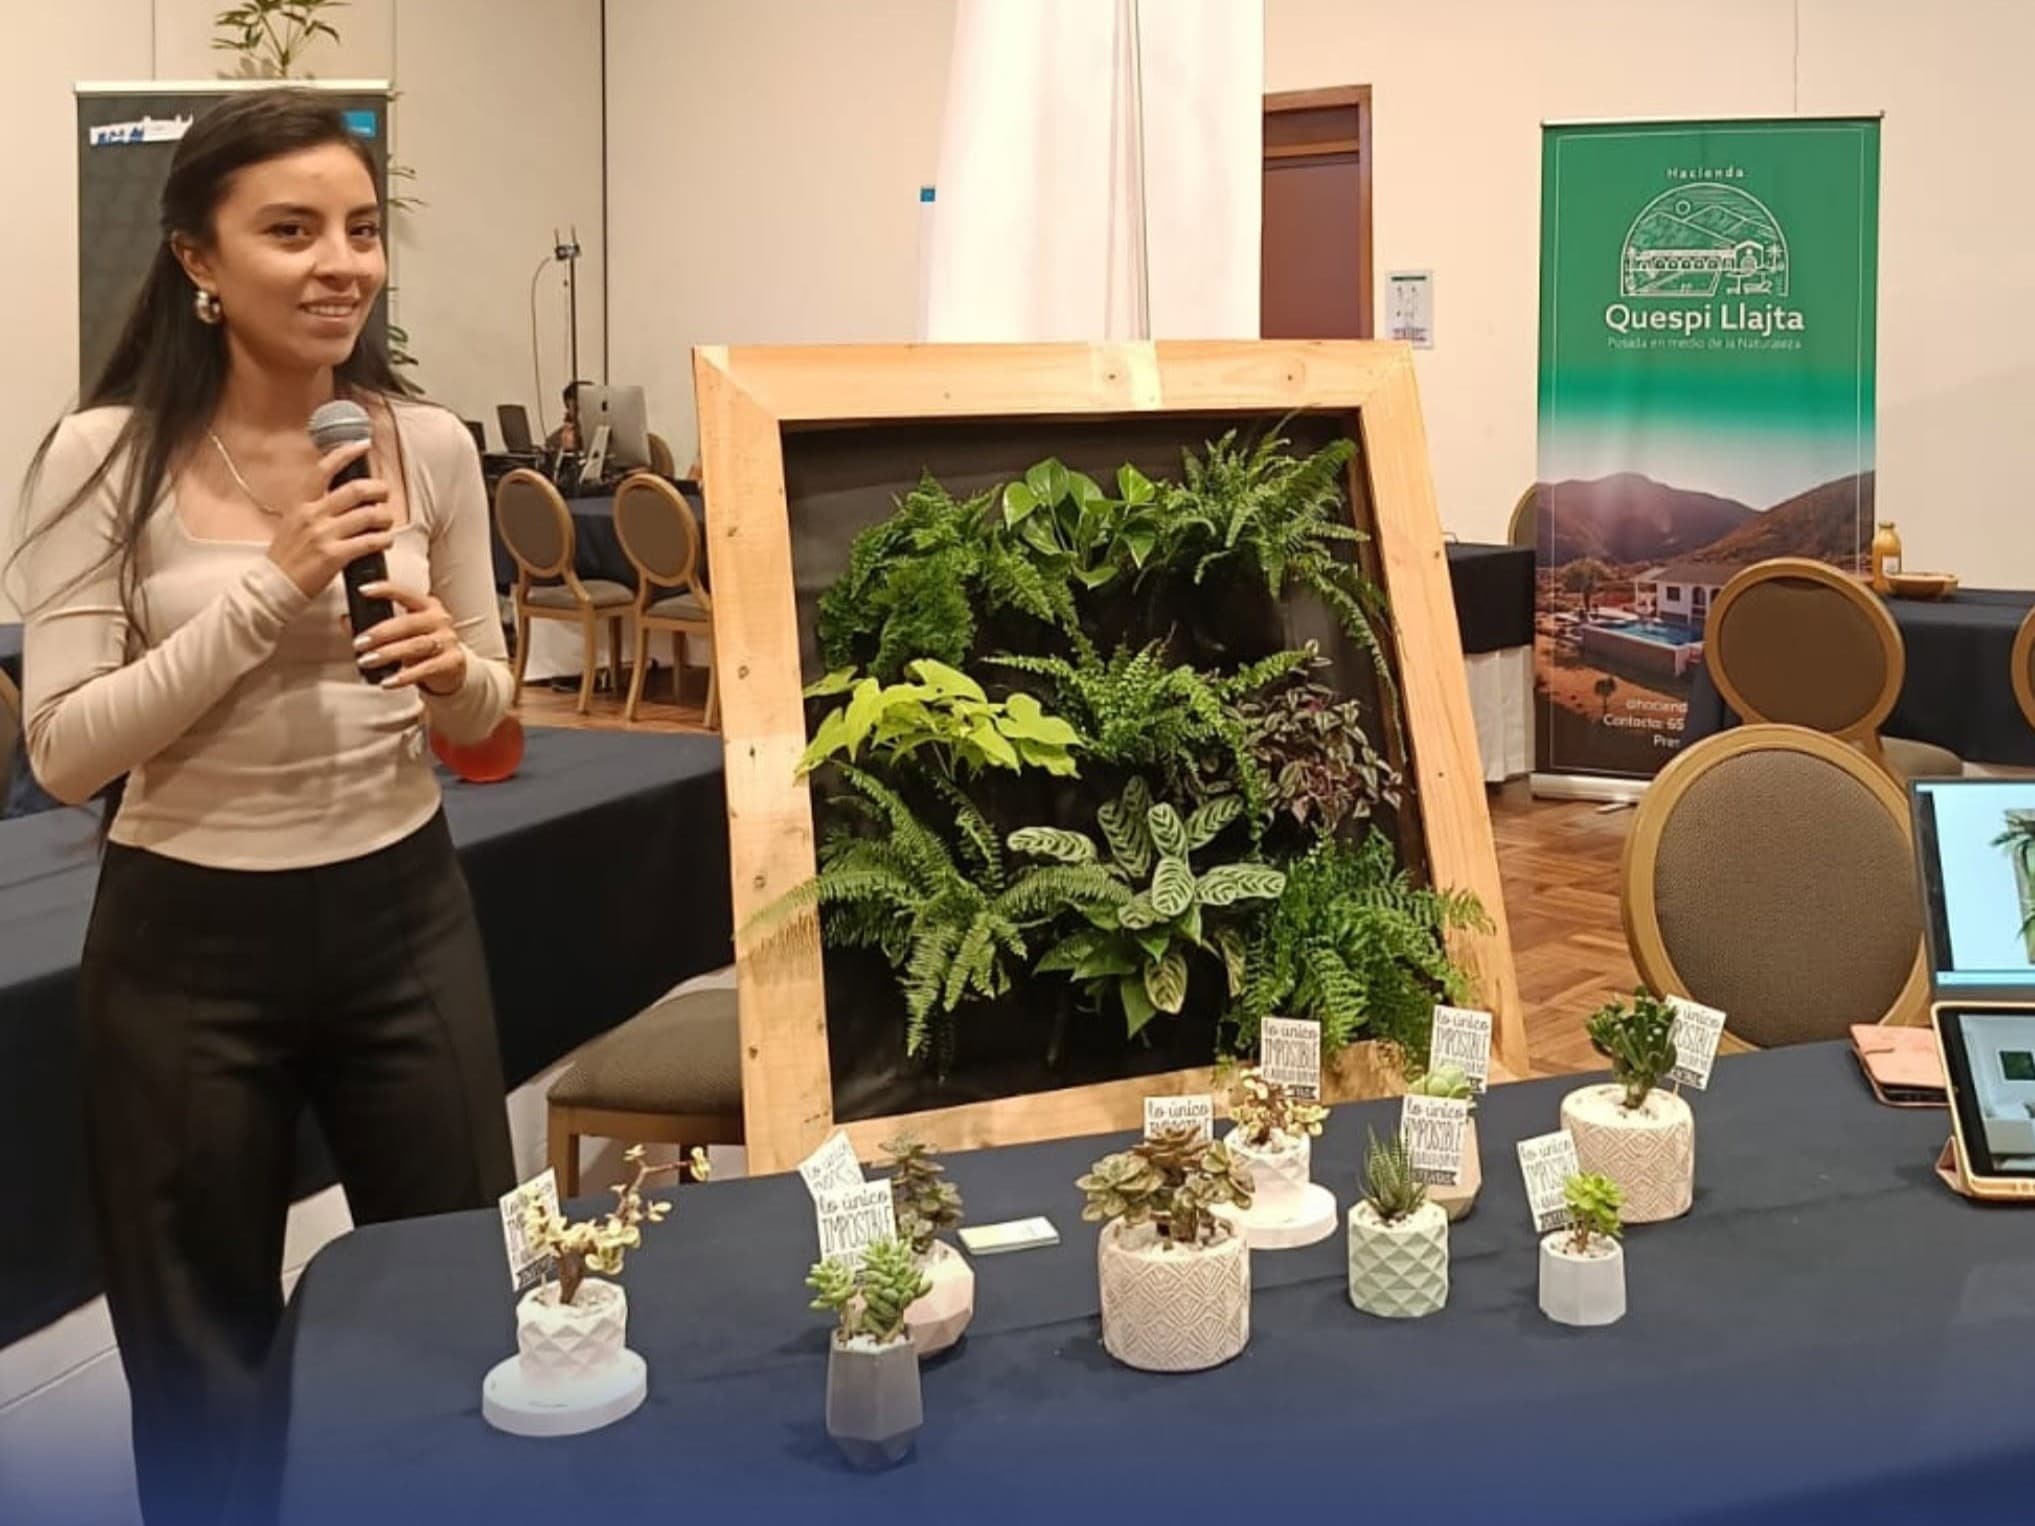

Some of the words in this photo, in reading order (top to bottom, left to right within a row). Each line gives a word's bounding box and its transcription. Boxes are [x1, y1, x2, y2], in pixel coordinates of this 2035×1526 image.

[1667, 165, 1744, 178] Hacienda
[1606, 304, 1711, 336] Quespi
[1721, 303, 1805, 336] Llajta
[1650, 338, 1665, 349] en
[1668, 337, 1705, 349] medio
[1708, 337, 1722, 349] de
[1725, 338, 1736, 349] la
[1738, 337, 1801, 350] Naturaleza
